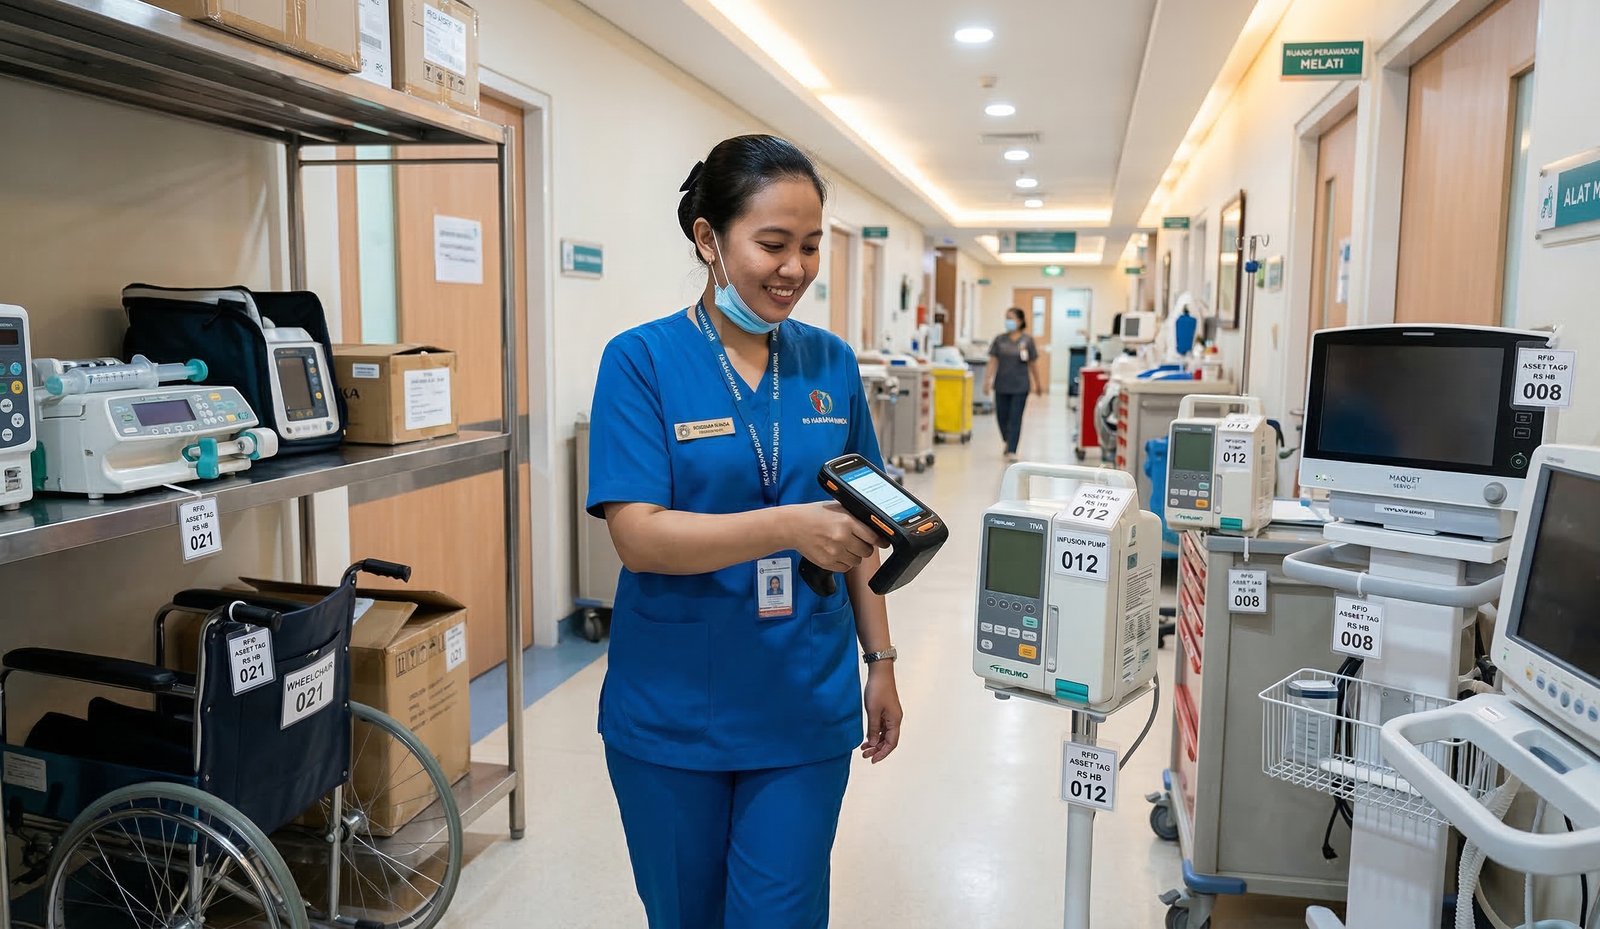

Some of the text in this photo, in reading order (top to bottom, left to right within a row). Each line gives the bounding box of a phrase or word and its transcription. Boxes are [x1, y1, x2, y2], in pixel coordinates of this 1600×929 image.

[1300, 58, 1344, 70] MELATI
[1563, 182, 1591, 207] ALAT
[1523, 383, 1562, 400] 008
[1223, 452, 1246, 464] 012
[1389, 474, 1421, 483] MAQUET
[192, 504, 206, 512] RFID
[1072, 506, 1109, 521] 012
[185, 514, 203, 523] ASSET
[1029, 522, 1044, 530] TIVA
[190, 531, 213, 550] 021
[1056, 536, 1106, 548] INFUSION PUMP
[1061, 551, 1098, 573] 012
[1234, 595, 1260, 607] 008
[1351, 604, 1368, 612] RFID
[1366, 615, 1379, 623] TAG
[1347, 622, 1370, 632] RS HB
[242, 636, 256, 646] RFID
[255, 642, 266, 650] TAG
[1341, 631, 1373, 650] 008
[242, 653, 262, 665] RS HB
[240, 662, 265, 683] 021
[287, 661, 334, 692] WHEELCHAIR
[990, 664, 1029, 679] TERUMO
[296, 681, 323, 713] 021
[1081, 750, 1099, 760] RFID
[1069, 758, 1111, 772] ASSET TAG
[1076, 770, 1102, 781] RS HB
[1070, 780, 1107, 803] 012
